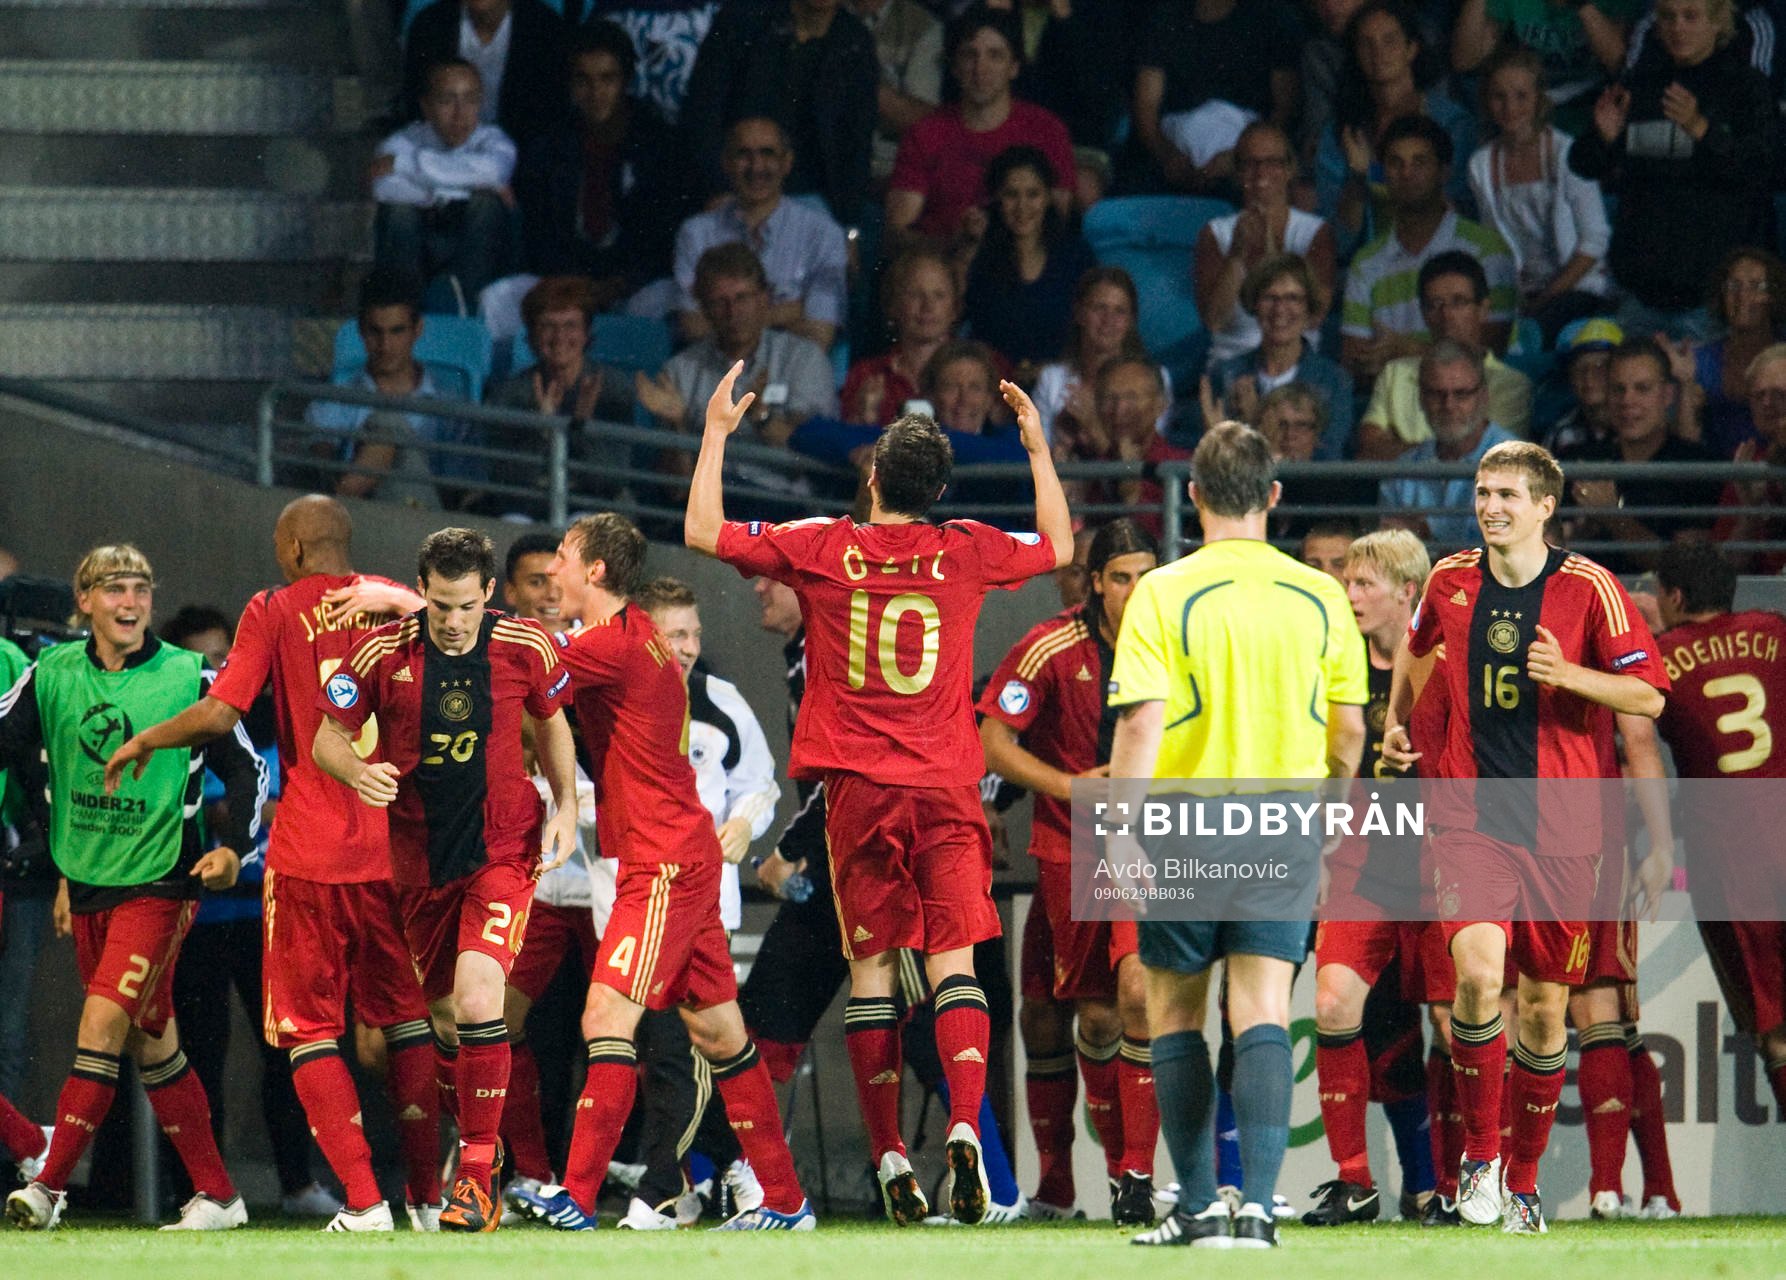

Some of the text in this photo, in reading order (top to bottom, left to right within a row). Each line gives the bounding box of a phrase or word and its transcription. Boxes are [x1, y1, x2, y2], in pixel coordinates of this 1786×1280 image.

[848, 588, 941, 695] 10
[1664, 631, 1779, 682] BOENISCH
[1484, 663, 1520, 710] 16
[1703, 674, 1772, 773] 3
[422, 730, 478, 765] 20
[481, 902, 525, 953] 20
[608, 935, 637, 976] 4
[1566, 931, 1589, 973] 16
[117, 954, 150, 998] 2
[1451, 1058, 1479, 1075] FB
[576, 1098, 594, 1110] FB
